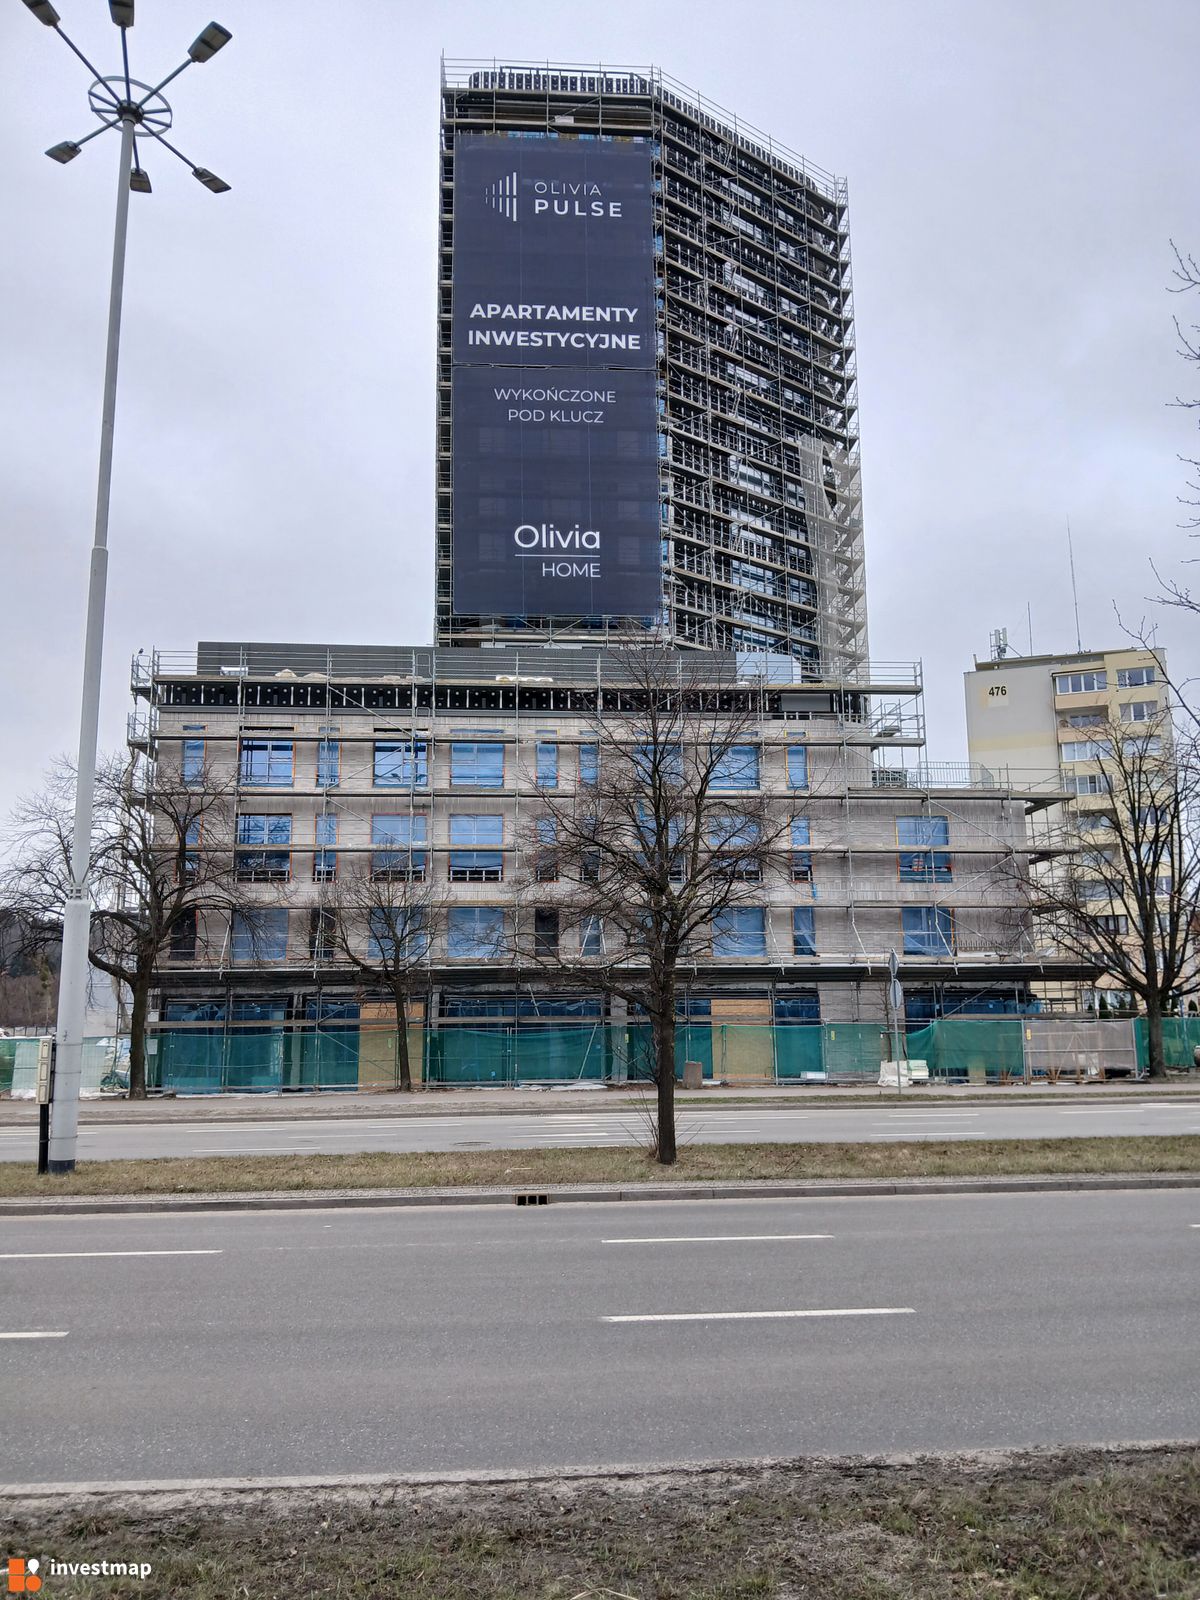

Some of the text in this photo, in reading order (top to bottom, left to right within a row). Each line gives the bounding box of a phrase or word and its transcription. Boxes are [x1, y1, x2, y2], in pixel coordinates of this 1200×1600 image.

[534, 181, 602, 196] OLIVIA
[534, 199, 622, 218] PULSE
[469, 303, 639, 323] APARTAMENTY
[467, 330, 641, 350] INWESTYCYJNE
[494, 386, 617, 403] WYKOŃCZONE
[508, 409, 604, 424] POD KLUCZ
[514, 523, 601, 549] Olivia
[542, 562, 601, 578] HOME
[988, 685, 1007, 697] 476
